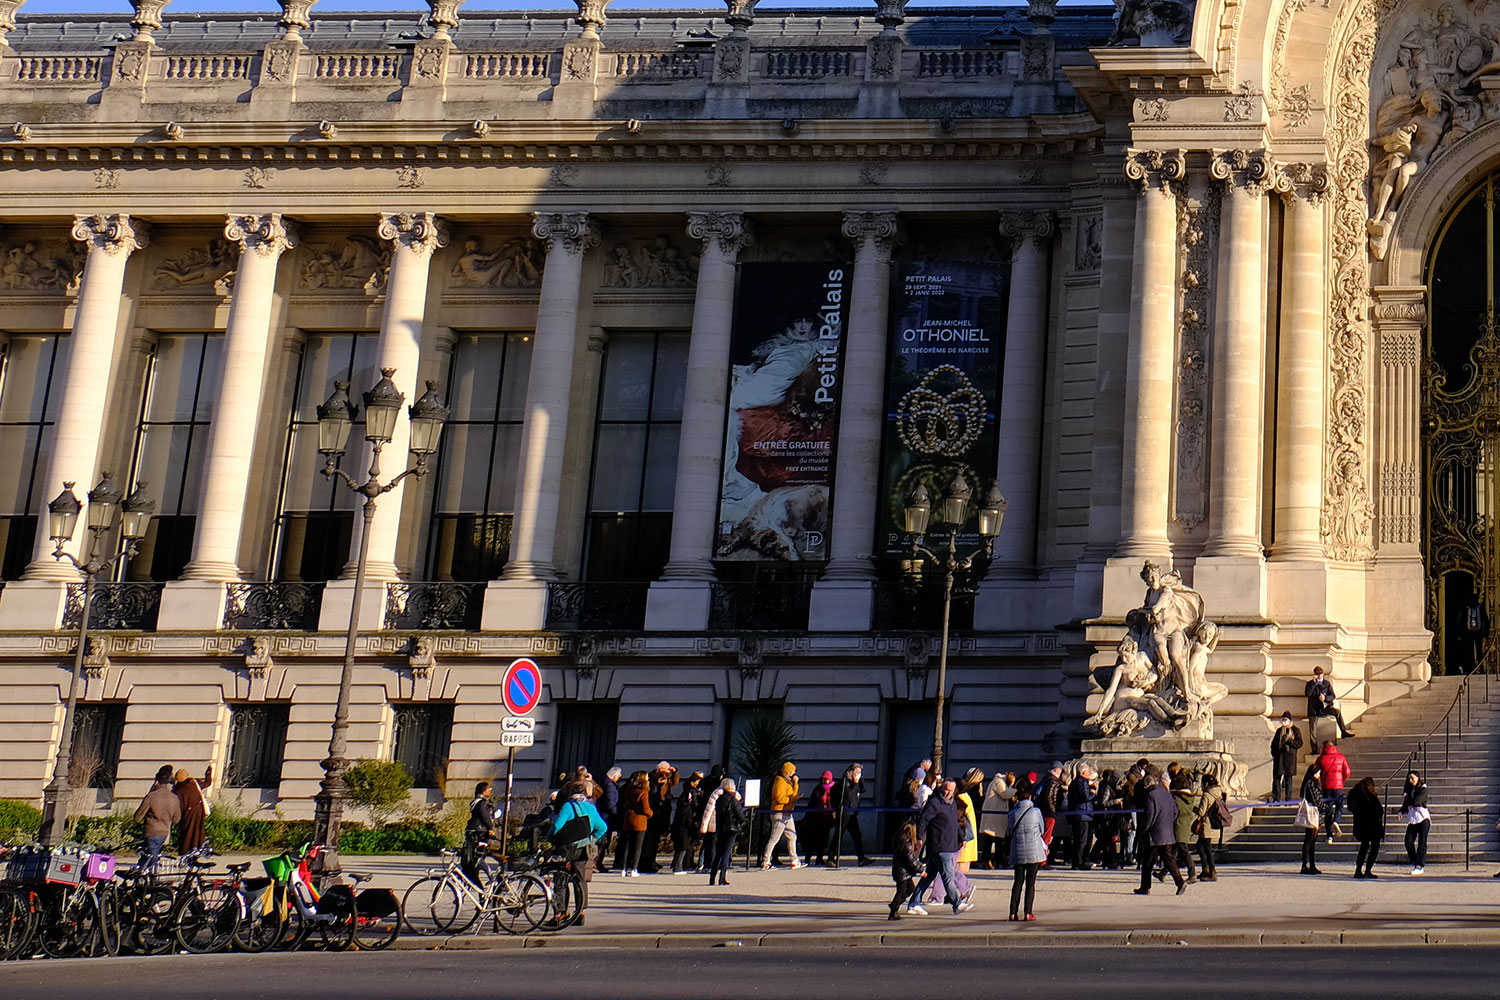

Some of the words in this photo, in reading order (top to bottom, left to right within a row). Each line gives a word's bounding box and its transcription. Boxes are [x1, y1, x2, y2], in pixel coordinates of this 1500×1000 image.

[820, 269, 844, 339] Palais
[903, 329, 989, 341] OTHONIEL
[815, 346, 838, 404] Petit
[754, 440, 787, 449] ENTRÉE
